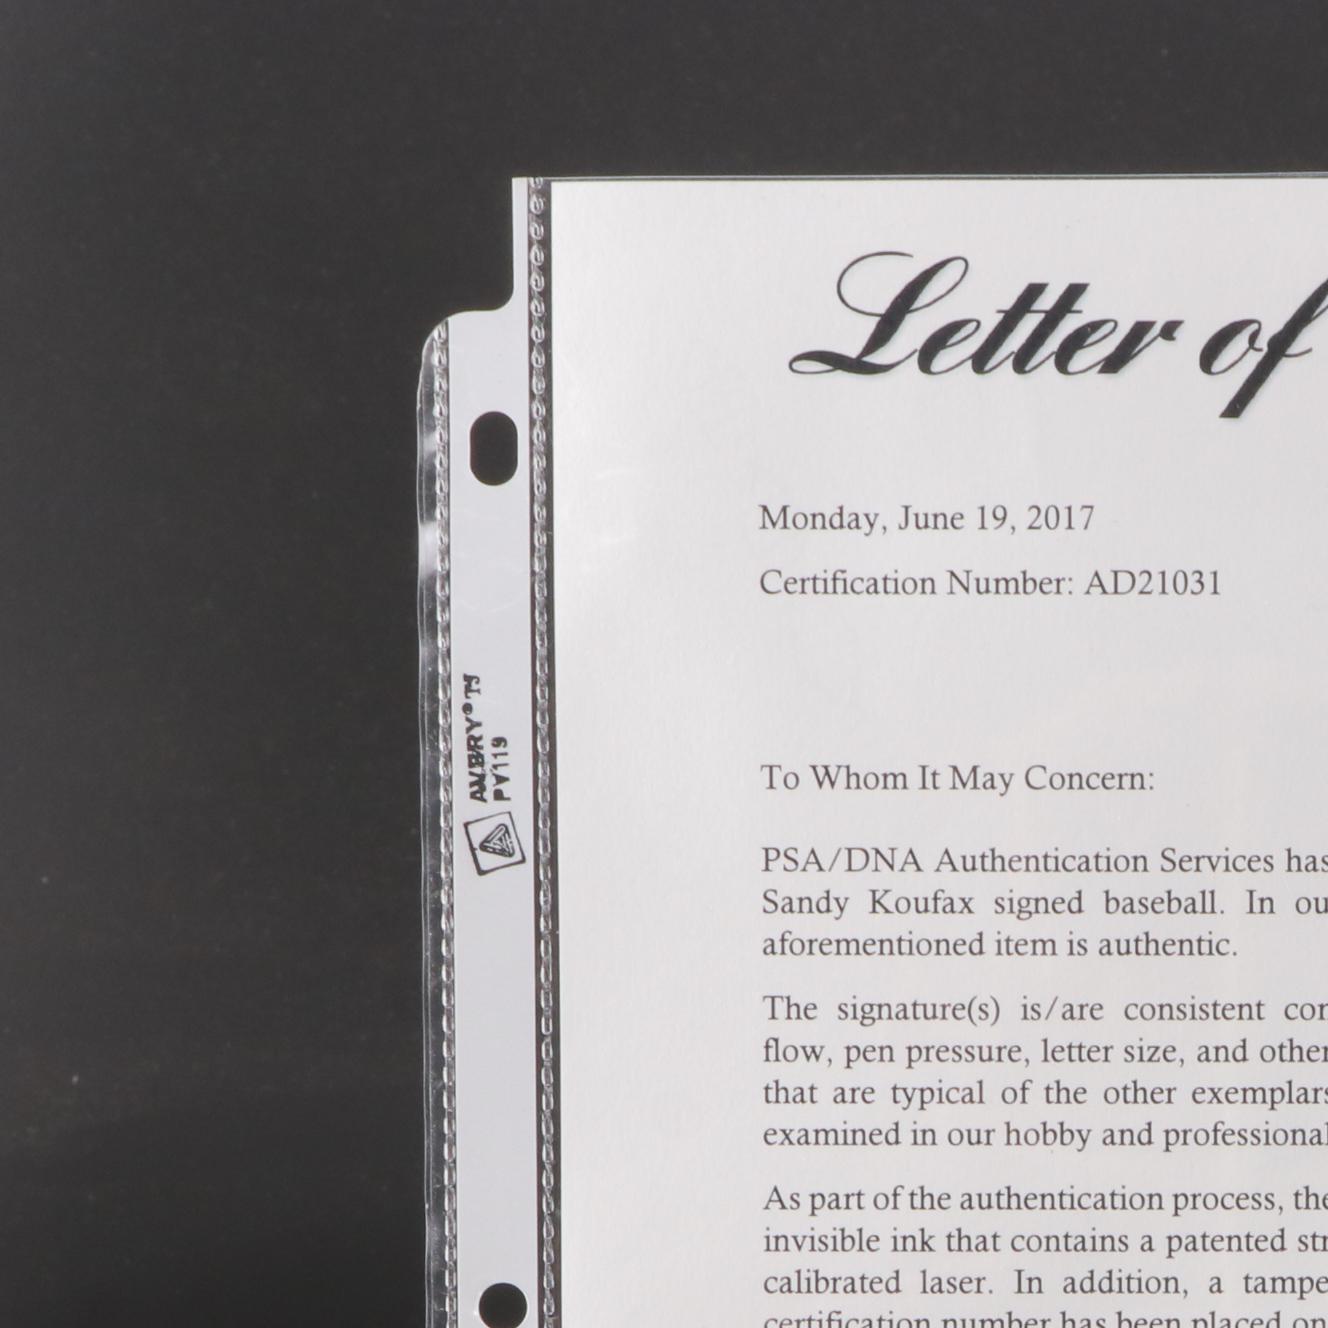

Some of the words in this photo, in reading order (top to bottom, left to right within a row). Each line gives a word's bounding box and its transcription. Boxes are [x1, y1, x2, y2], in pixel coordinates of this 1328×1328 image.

[791, 250, 1183, 376] Letter
[757, 503, 888, 537] Monday,
[897, 504, 965, 531] June
[977, 504, 1017, 536] 19,
[1026, 504, 1095, 531] 2017
[759, 568, 937, 596] Certification
[945, 568, 1073, 596] Number:
[1083, 569, 1221, 596] AD21031
[759, 764, 801, 791] To
[808, 763, 910, 791] Whom
[917, 764, 941, 791] It
[948, 764, 1015, 798] May
[1024, 764, 1155, 791] Concern:
[760, 846, 925, 873] PSA/DNA
[933, 846, 1150, 873] Authentication
[1160, 846, 1275, 874] Services
[762, 888, 850, 921] Sandy
[868, 888, 976, 915] Koufax
[993, 888, 1085, 922] signed
[1102, 888, 1225, 915] baseball.
[1245, 888, 1276, 915] In
[762, 994, 819, 1021] The
[837, 994, 1001, 1028] signature(s)
[1020, 994, 1105, 1022] is/are
[1123, 994, 1266, 1022] consistent
[763, 1036, 833, 1068] flow,
[843, 1044, 896, 1070] pen
[904, 1044, 1030, 1070] pressure,
[1040, 1037, 1115, 1064] letter
[1123, 1037, 1185, 1068] size,
[1196, 1037, 1250, 1064] and
[762, 1120, 903, 1147] examined
[910, 1120, 939, 1147] in
[947, 1127, 997, 1147] our
[1003, 1120, 1093, 1153] hobby
[1101, 1120, 1155, 1147] and
[762, 1184, 801, 1211] As
[808, 1189, 866, 1218] part
[872, 1184, 906, 1211] of
[908, 1184, 952, 1211] the
[959, 1184, 1165, 1212] authentication
[1171, 1191, 1284, 1218] process,
[763, 1226, 881, 1253] invisible
[890, 1226, 937, 1253] ink
[945, 1226, 1002, 1253] that
[1010, 1226, 1130, 1253] contains
[1139, 1234, 1156, 1253] a
[1165, 1226, 1288, 1260] patented
[763, 1268, 903, 1295] calibrated
[919, 1268, 994, 1295] laser.
[1013, 1268, 1045, 1295] In
[1062, 1268, 1189, 1299] addition,
[1208, 1275, 1225, 1295] a
